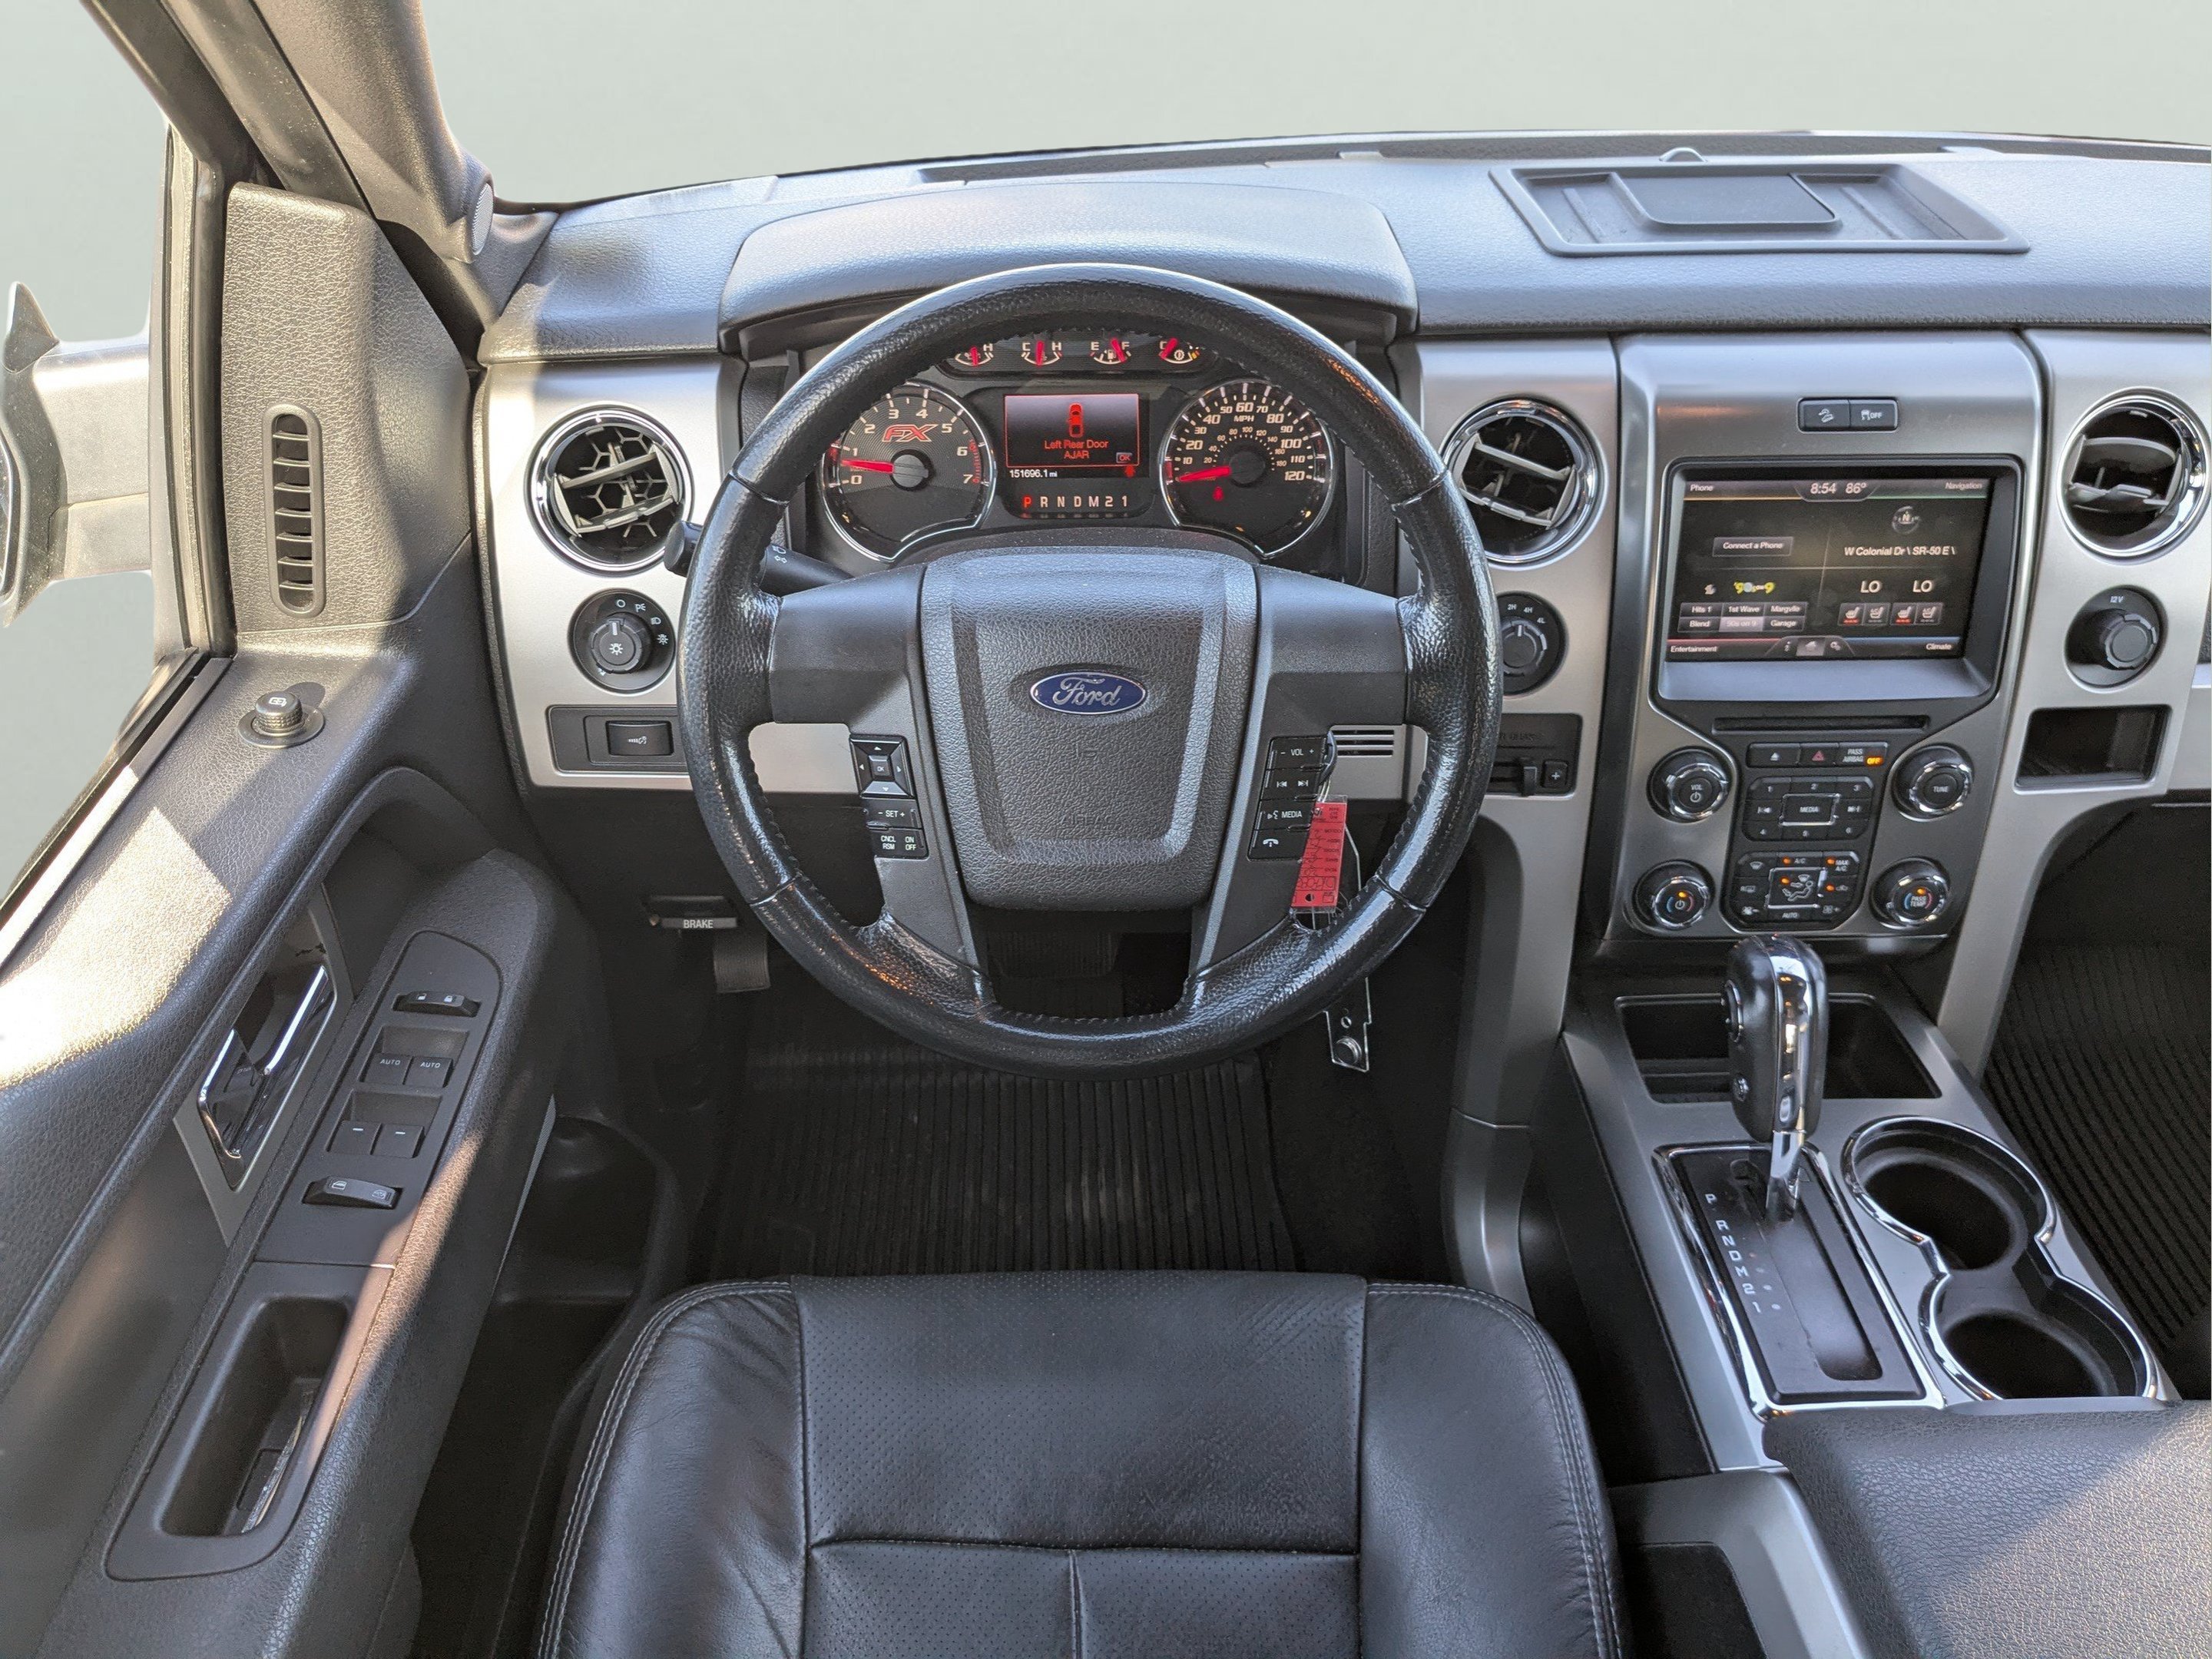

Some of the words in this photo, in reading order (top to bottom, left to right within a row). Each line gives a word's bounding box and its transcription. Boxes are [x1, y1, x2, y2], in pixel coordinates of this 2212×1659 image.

[1022, 343, 1031, 351] C
[1051, 342, 1061, 351] H
[1091, 342, 1099, 351] E
[1220, 406, 1233, 414] 50
[1236, 402, 1253, 412] 60
[888, 409, 899, 419] 3
[916, 409, 928, 419] 4
[1266, 413, 1284, 423] 80
[1203, 415, 1221, 424] 40
[864, 424, 876, 434] 2
[882, 424, 939, 442] FX
[942, 423, 952, 433] 5
[1045, 441, 1062, 449] Left
[1063, 440, 1084, 449] Rear
[1086, 439, 1109, 449] Door
[1185, 440, 1204, 450] 20
[1280, 439, 1302, 449] 100
[853, 448, 858, 456] 1
[957, 446, 968, 456] 6
[1064, 451, 1089, 459] AJAR
[1009, 469, 1048, 478] 151696.1
[1284, 471, 1305, 481] 120
[850, 475, 863, 485] 0
[963, 474, 973, 484] 7
[1810, 482, 1837, 494] 8:54
[1945, 482, 1982, 491] Navigation
[1024, 497, 1031, 508] P
[1040, 497, 1048, 507] R
[1057, 497, 1065, 507] N
[1074, 497, 1082, 507] D
[1088, 496, 1099, 507] M
[1104, 496, 1113, 507] 2
[1121, 495, 1128, 507] 1
[1723, 541, 1753, 550] Connect
[1844, 547, 1855, 556] W
[1856, 546, 1892, 556] Colonial
[1893, 546, 1906, 555] Dr
[1912, 545, 1942, 555] SR-50
[1942, 545, 1950, 555] E
[1860, 580, 1881, 594] LO
[1912, 579, 1934, 593] LO
[1052, 676, 1123, 706] Ford
[684, 919, 714, 929] BRAKE
[1705, 1194, 1717, 1204] P
[1716, 1220, 1730, 1230] R
[1722, 1236, 1736, 1246] N
[1729, 1250, 1742, 1261] D
[1735, 1267, 1749, 1277] M
[1743, 1283, 1755, 1294] 2
[1753, 1302, 1761, 1313] 1
